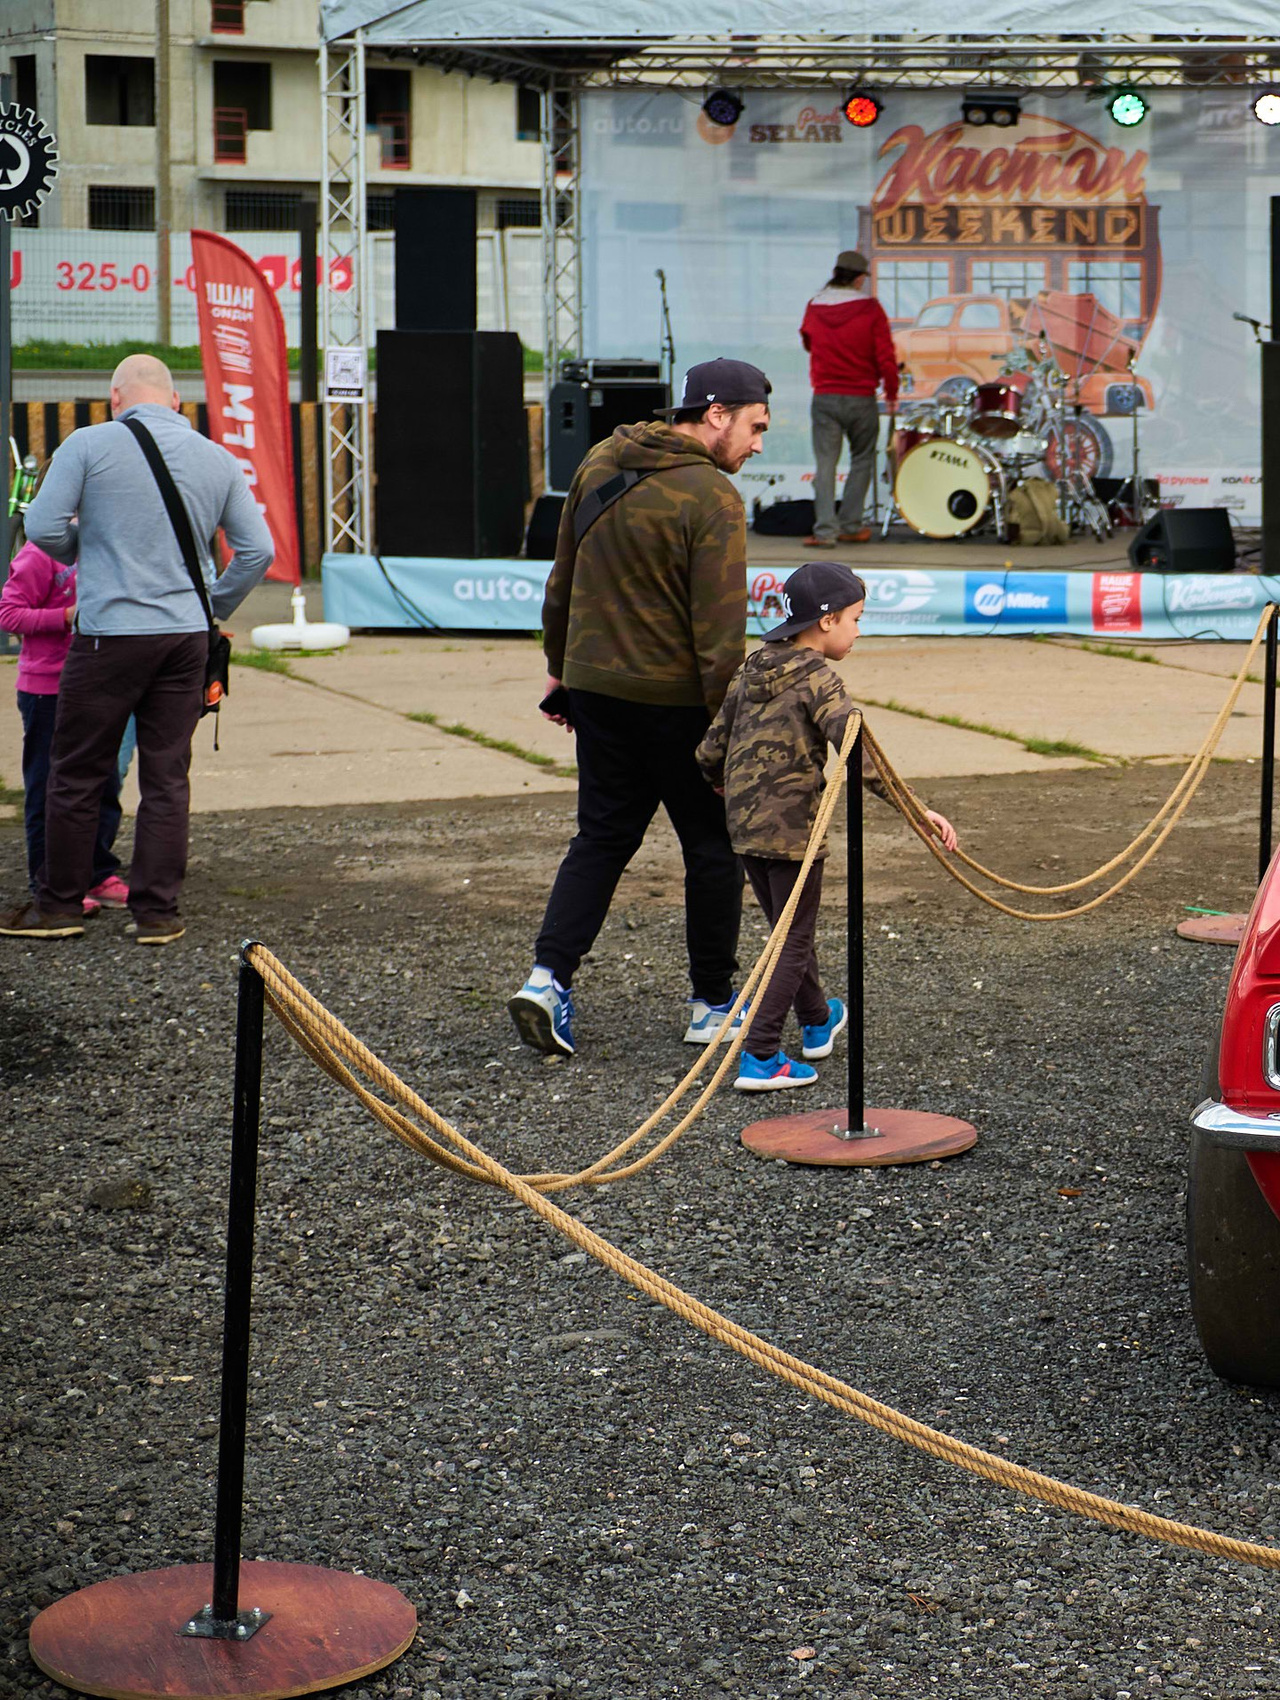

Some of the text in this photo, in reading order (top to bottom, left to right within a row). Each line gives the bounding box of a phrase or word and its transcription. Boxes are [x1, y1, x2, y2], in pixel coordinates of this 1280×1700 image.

[593, 116, 685, 135] auto.ru
[750, 124, 844, 144] SELAR
[878, 207, 1140, 245] WEEKEND
[453, 576, 542, 602] auto.
[751, 572, 786, 602] Pa
